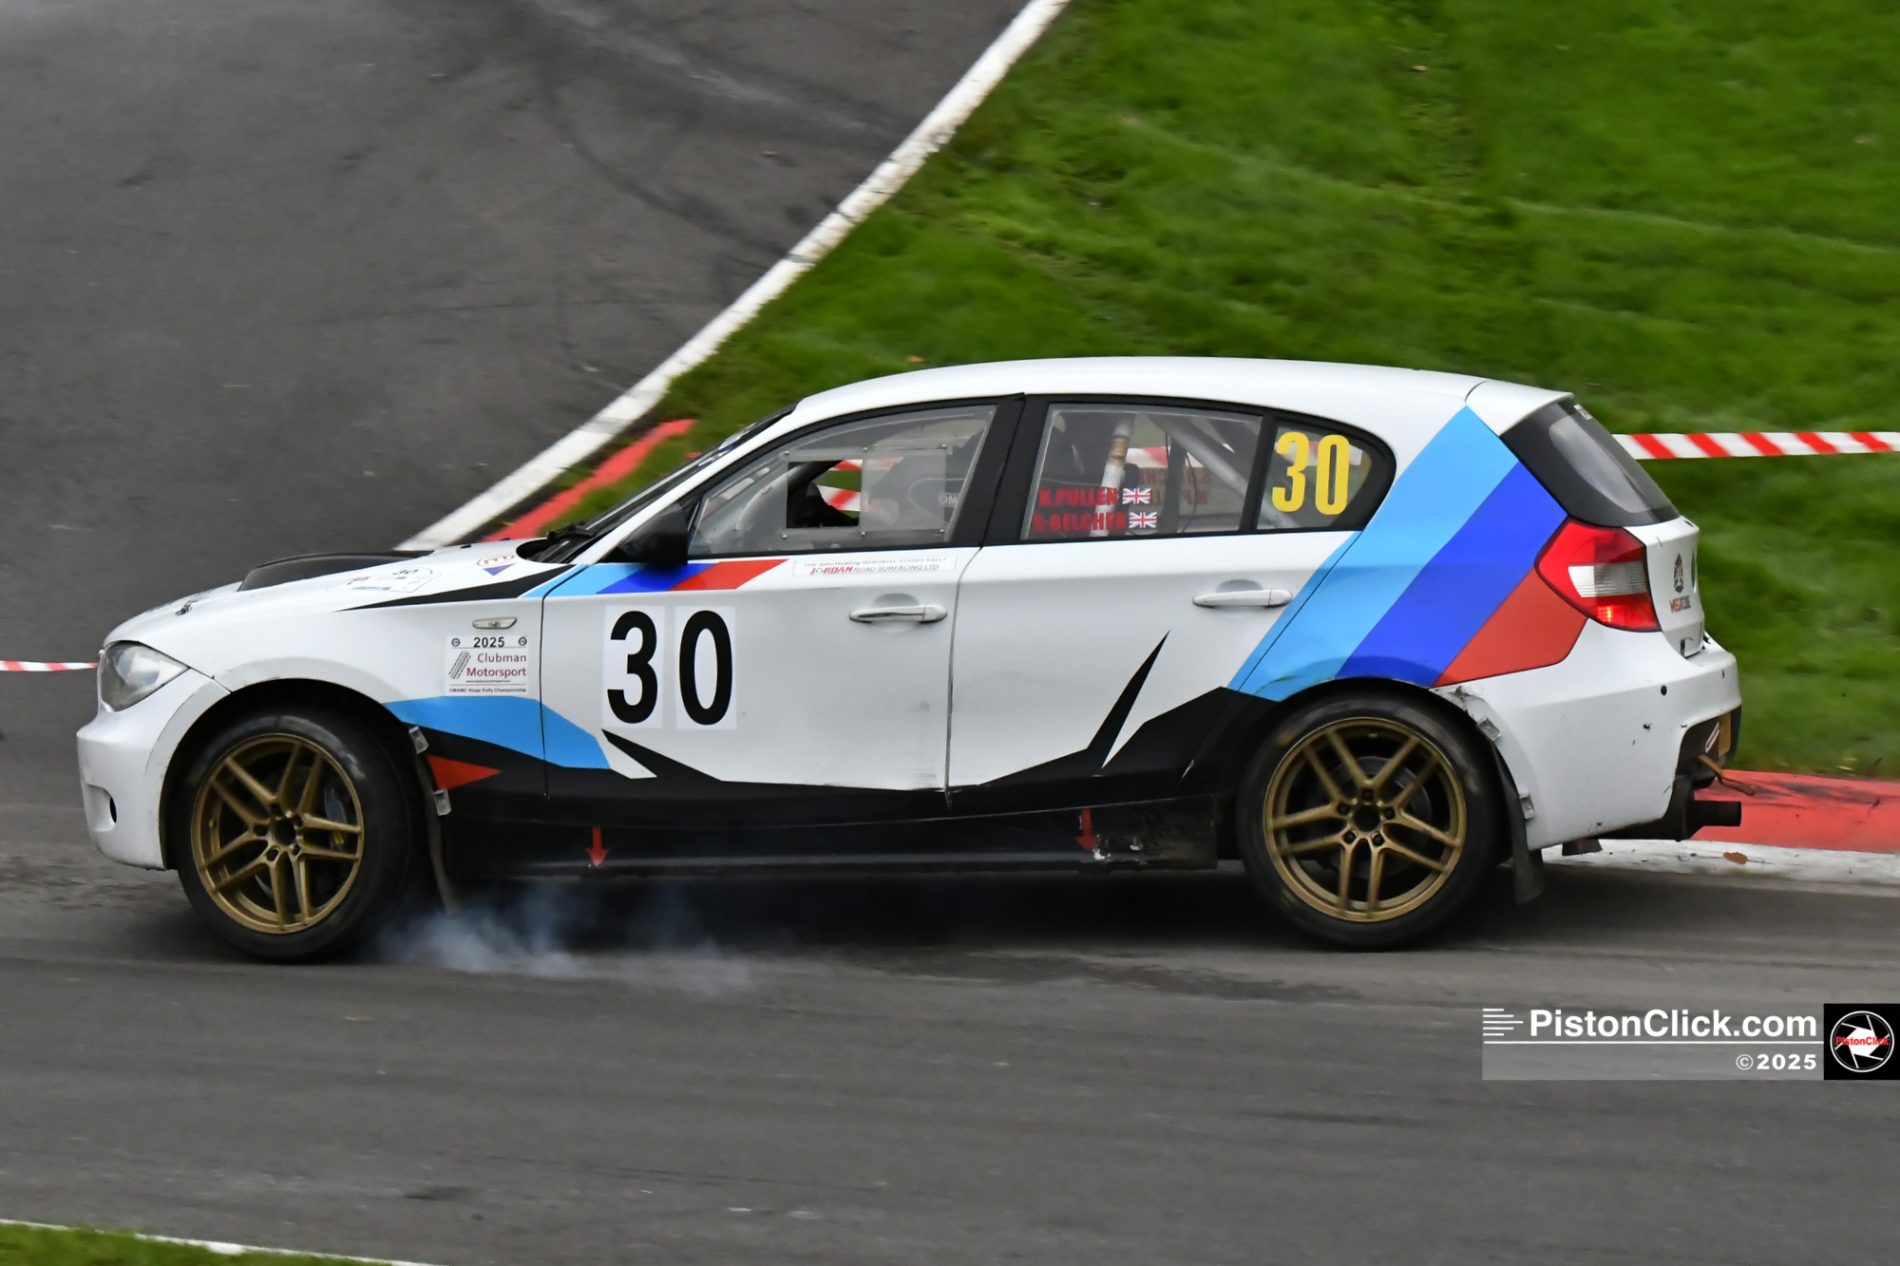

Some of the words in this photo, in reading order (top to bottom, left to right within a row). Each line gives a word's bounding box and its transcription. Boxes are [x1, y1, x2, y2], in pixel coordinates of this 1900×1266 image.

[1271, 431, 1350, 515] 30
[854, 566, 876, 574] ROAD
[878, 564, 923, 573] SURFACING
[473, 636, 505, 648] 2025
[477, 652, 527, 663] Clubman
[466, 667, 527, 679] Motorsport
[607, 610, 733, 725] 30
